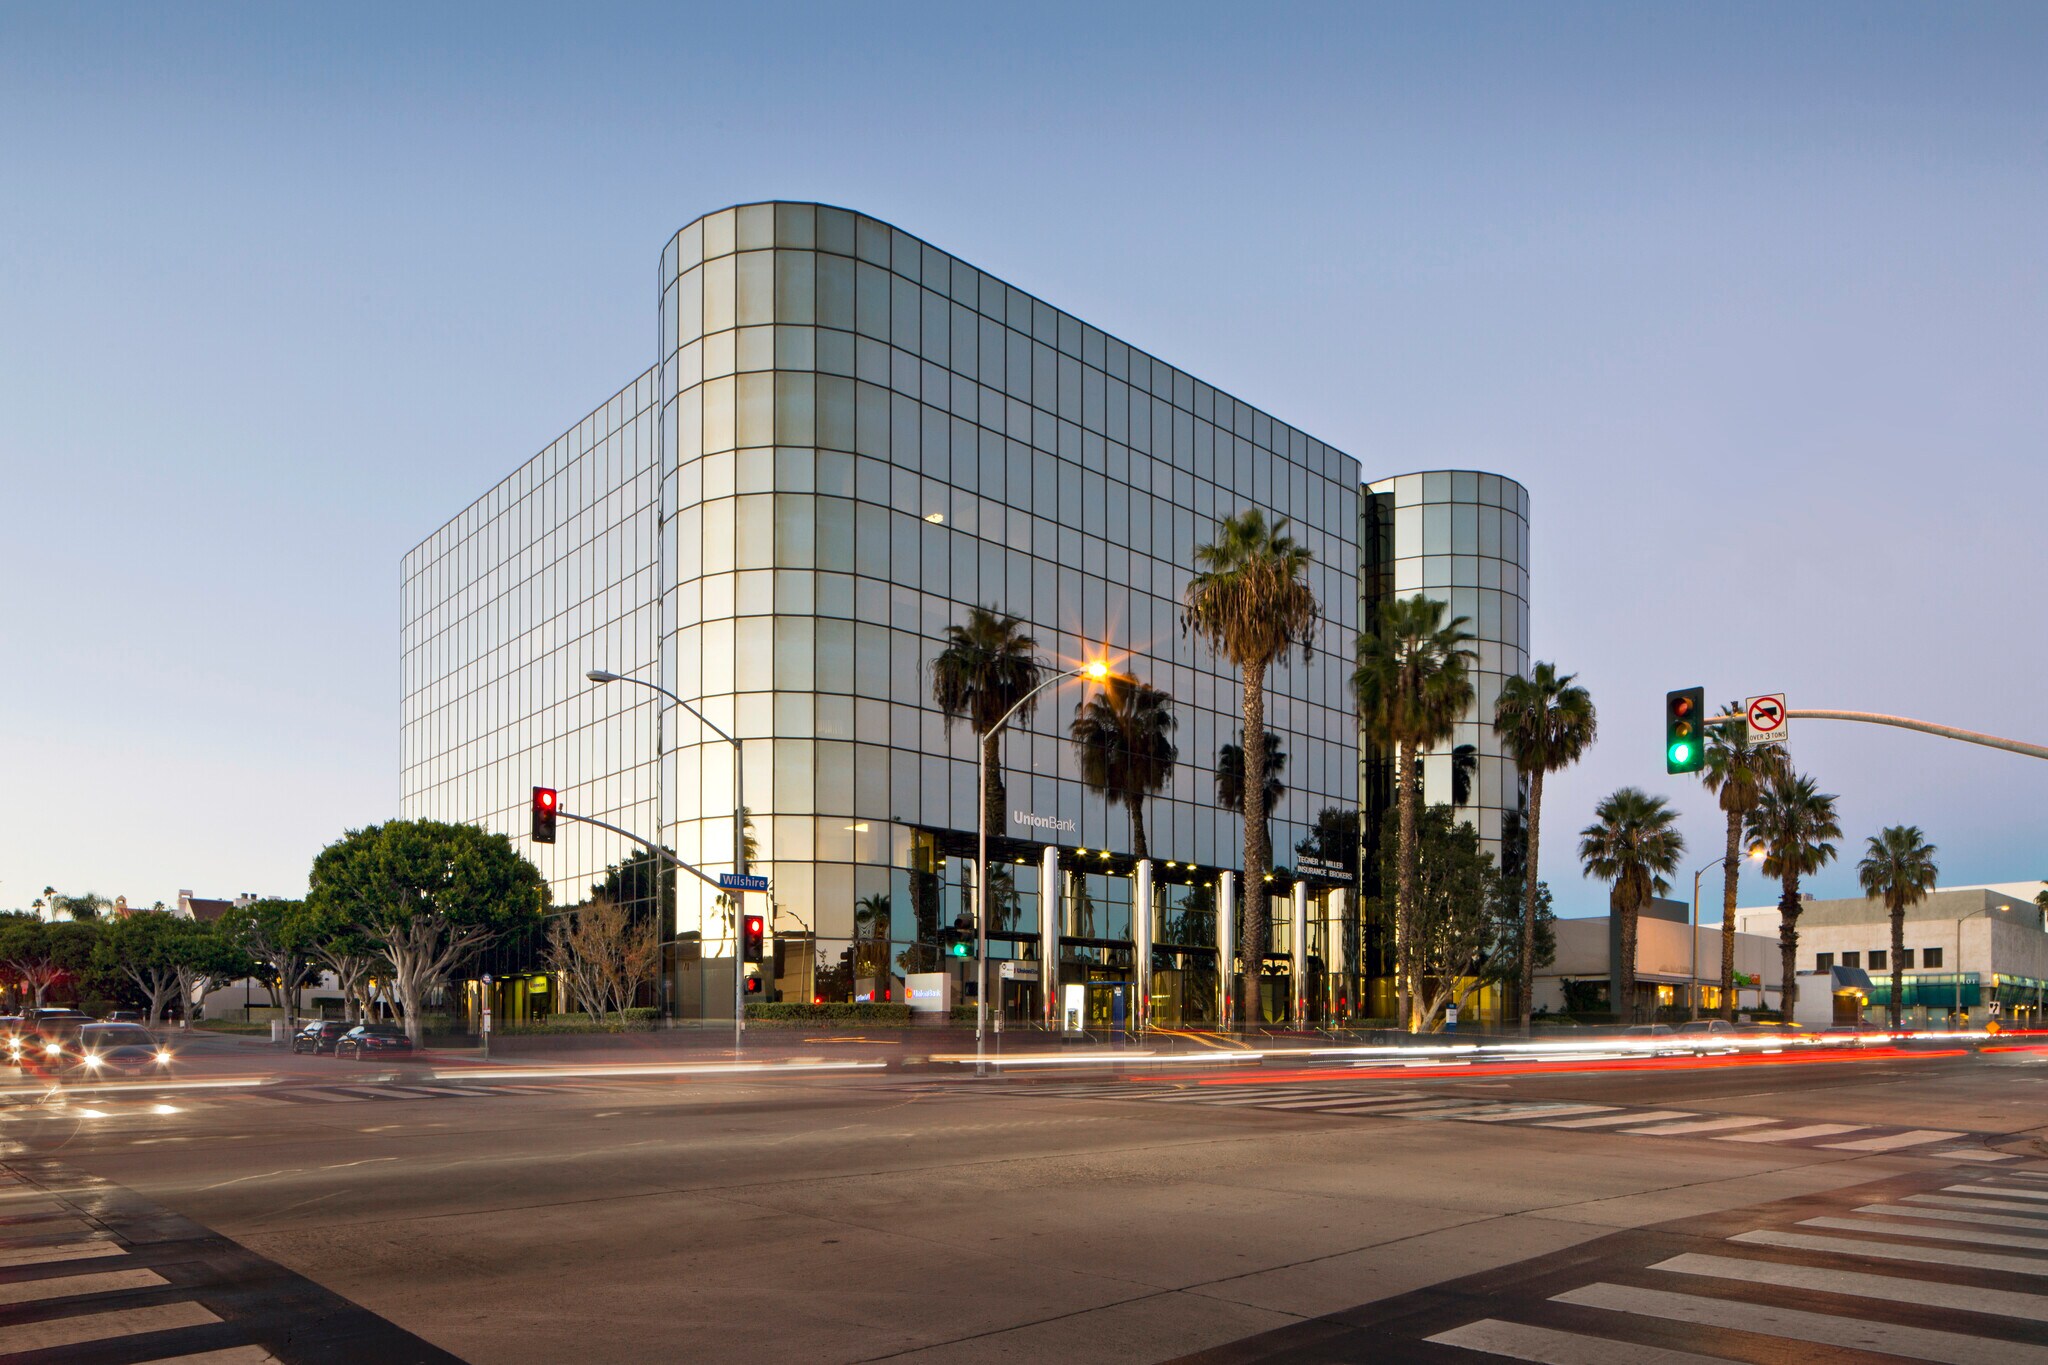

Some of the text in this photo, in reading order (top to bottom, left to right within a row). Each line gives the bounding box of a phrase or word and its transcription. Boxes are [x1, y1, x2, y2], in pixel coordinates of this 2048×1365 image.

[1750, 733, 1764, 741] OVER
[1765, 732, 1771, 740] 3
[1013, 810, 1076, 832] UnionBank
[1298, 855, 1319, 866] TEGNER
[1325, 860, 1344, 870] MILLER
[1297, 865, 1353, 880] INSURANCE BROKERS
[722, 875, 766, 888] Wilshire
